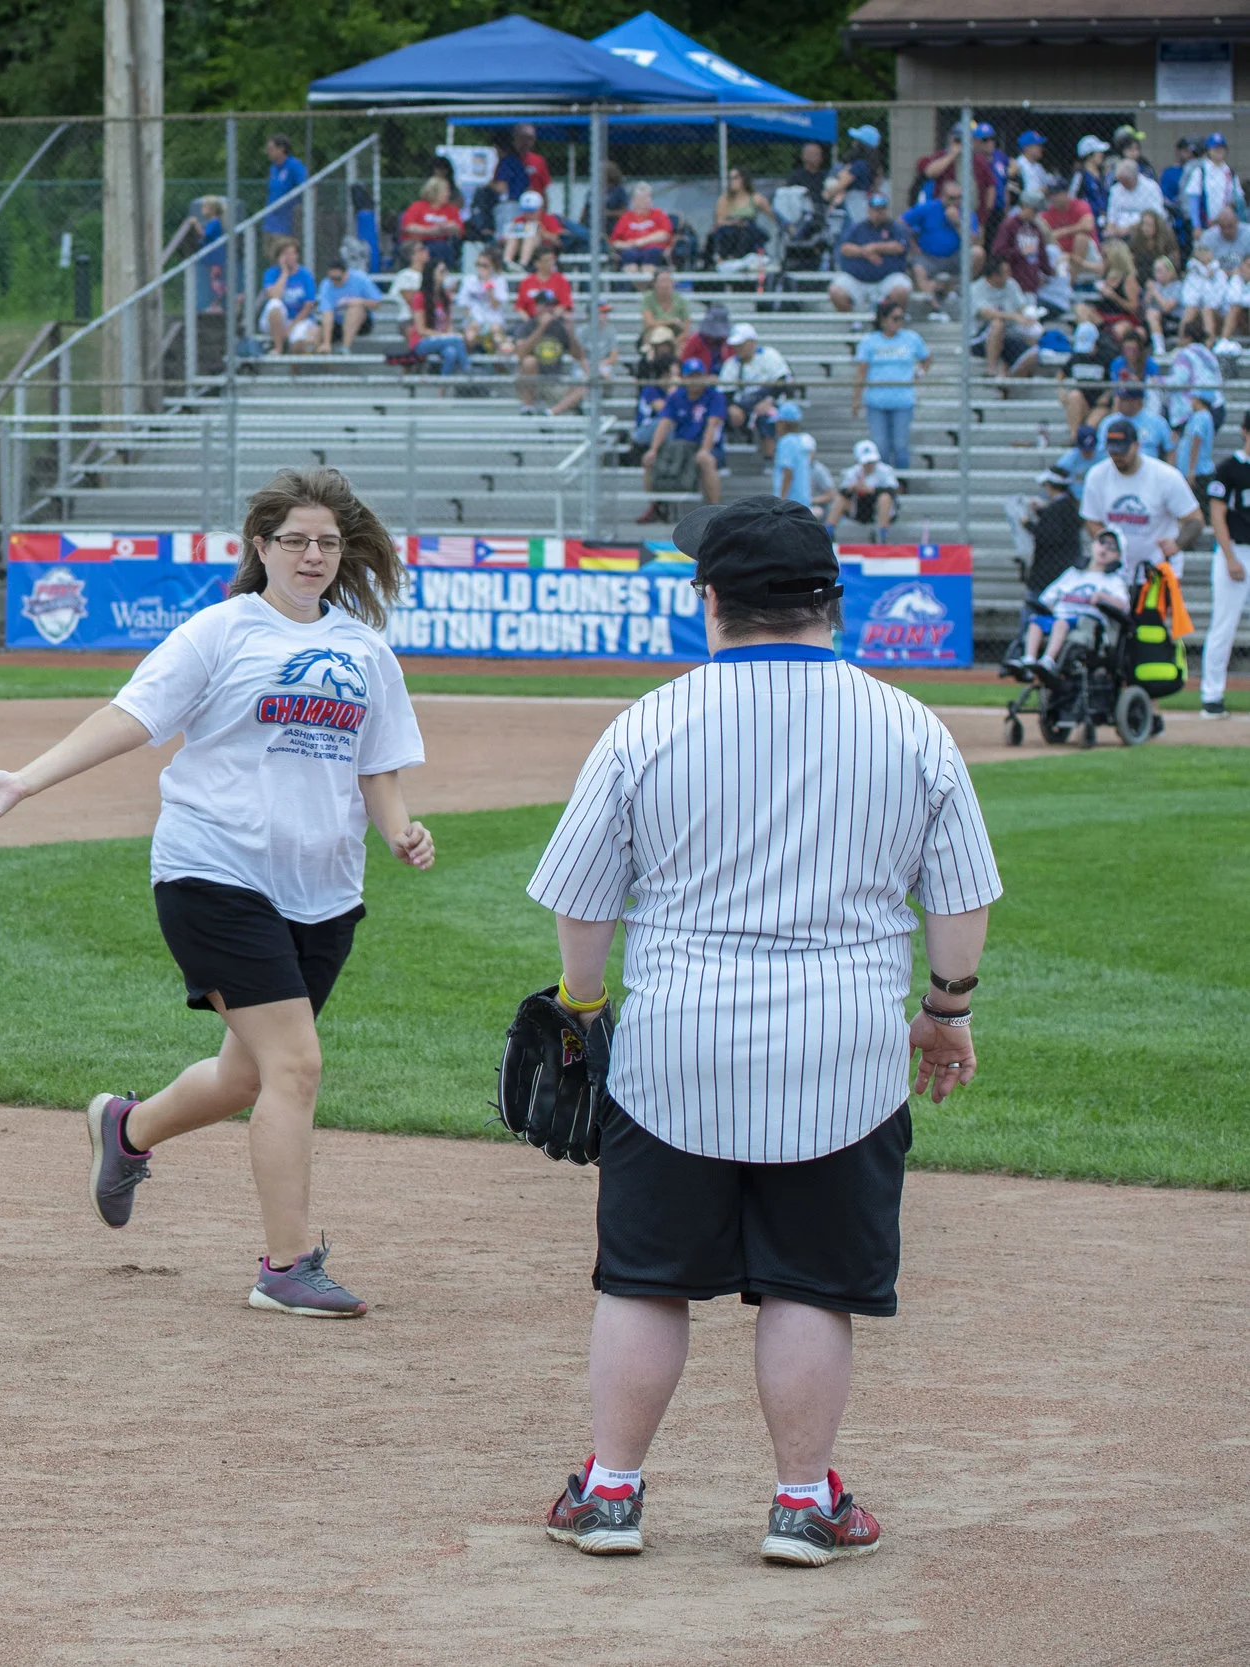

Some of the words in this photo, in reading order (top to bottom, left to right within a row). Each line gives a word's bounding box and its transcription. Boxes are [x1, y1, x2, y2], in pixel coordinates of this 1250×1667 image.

[421, 571, 532, 611] WORLD
[537, 573, 650, 614] COMES
[655, 577, 699, 617] TO
[496, 611, 623, 653] COUNTY
[628, 616, 674, 655] PA
[865, 624, 948, 645] PONY
[290, 738, 318, 750] AUGUST
[338, 735, 350, 746] PA
[266, 746, 299, 754] Sponsored
[300, 749, 312, 758] By:
[784, 1485, 818, 1493] PUMA
[612, 1503, 622, 1524] FILA
[780, 1510, 792, 1531] FILA
[848, 1528, 870, 1537] FILA
